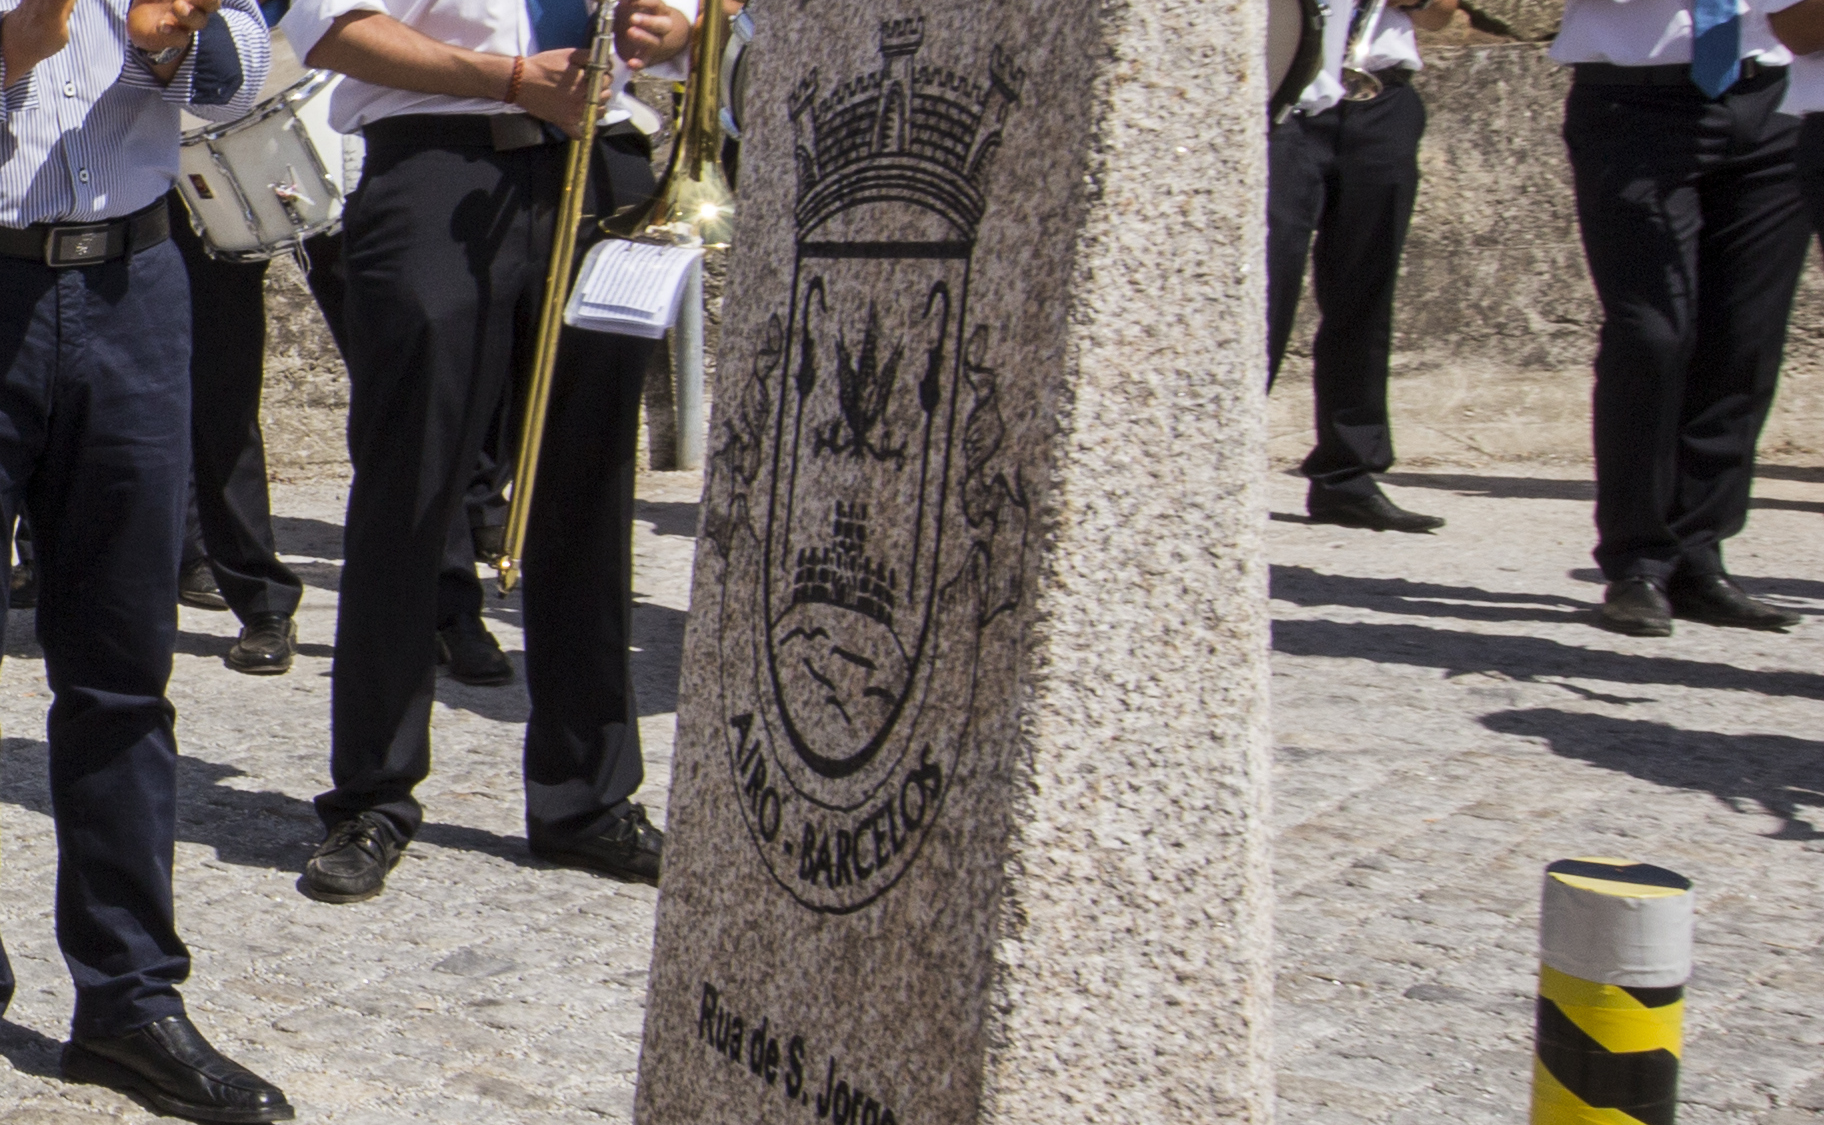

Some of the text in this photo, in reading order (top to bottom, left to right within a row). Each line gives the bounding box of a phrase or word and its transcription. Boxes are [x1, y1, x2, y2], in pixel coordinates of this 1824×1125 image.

[799, 741, 942, 890] BARCELOS
[699, 981, 744, 1064] Rua
[750, 1015, 780, 1086] de
[785, 1034, 809, 1107] S.
